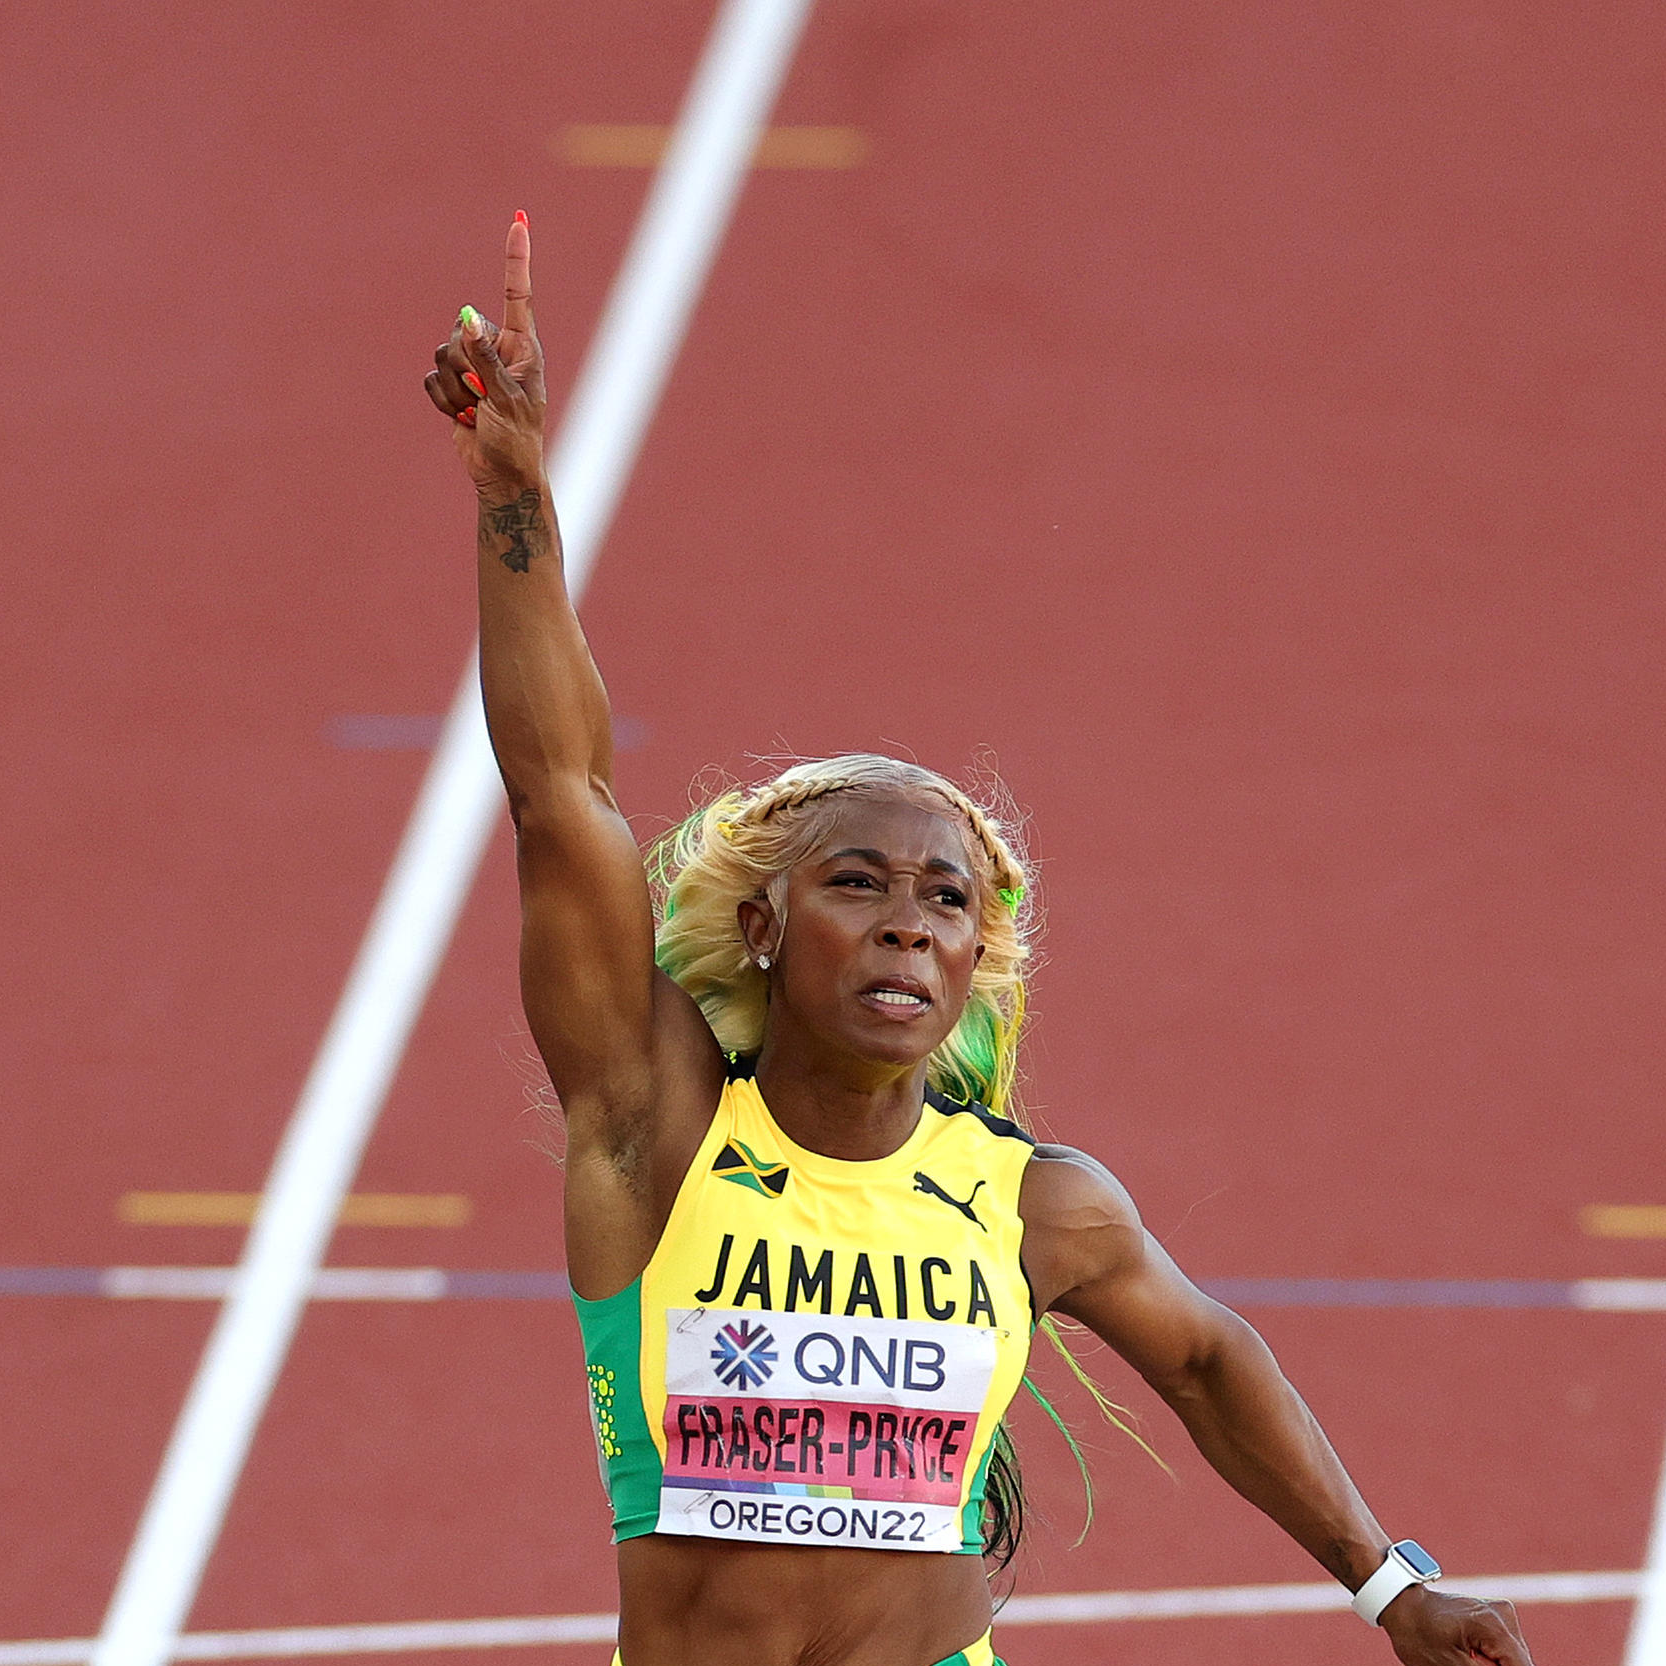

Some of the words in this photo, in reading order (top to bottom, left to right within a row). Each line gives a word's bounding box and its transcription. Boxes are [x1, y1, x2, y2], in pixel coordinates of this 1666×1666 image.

[694, 1233, 998, 1328] JAMAICA
[793, 1331, 947, 1392] QNB
[676, 1403, 968, 1484] FRASER-PRYCE
[708, 1498, 927, 1543] OREGON22
